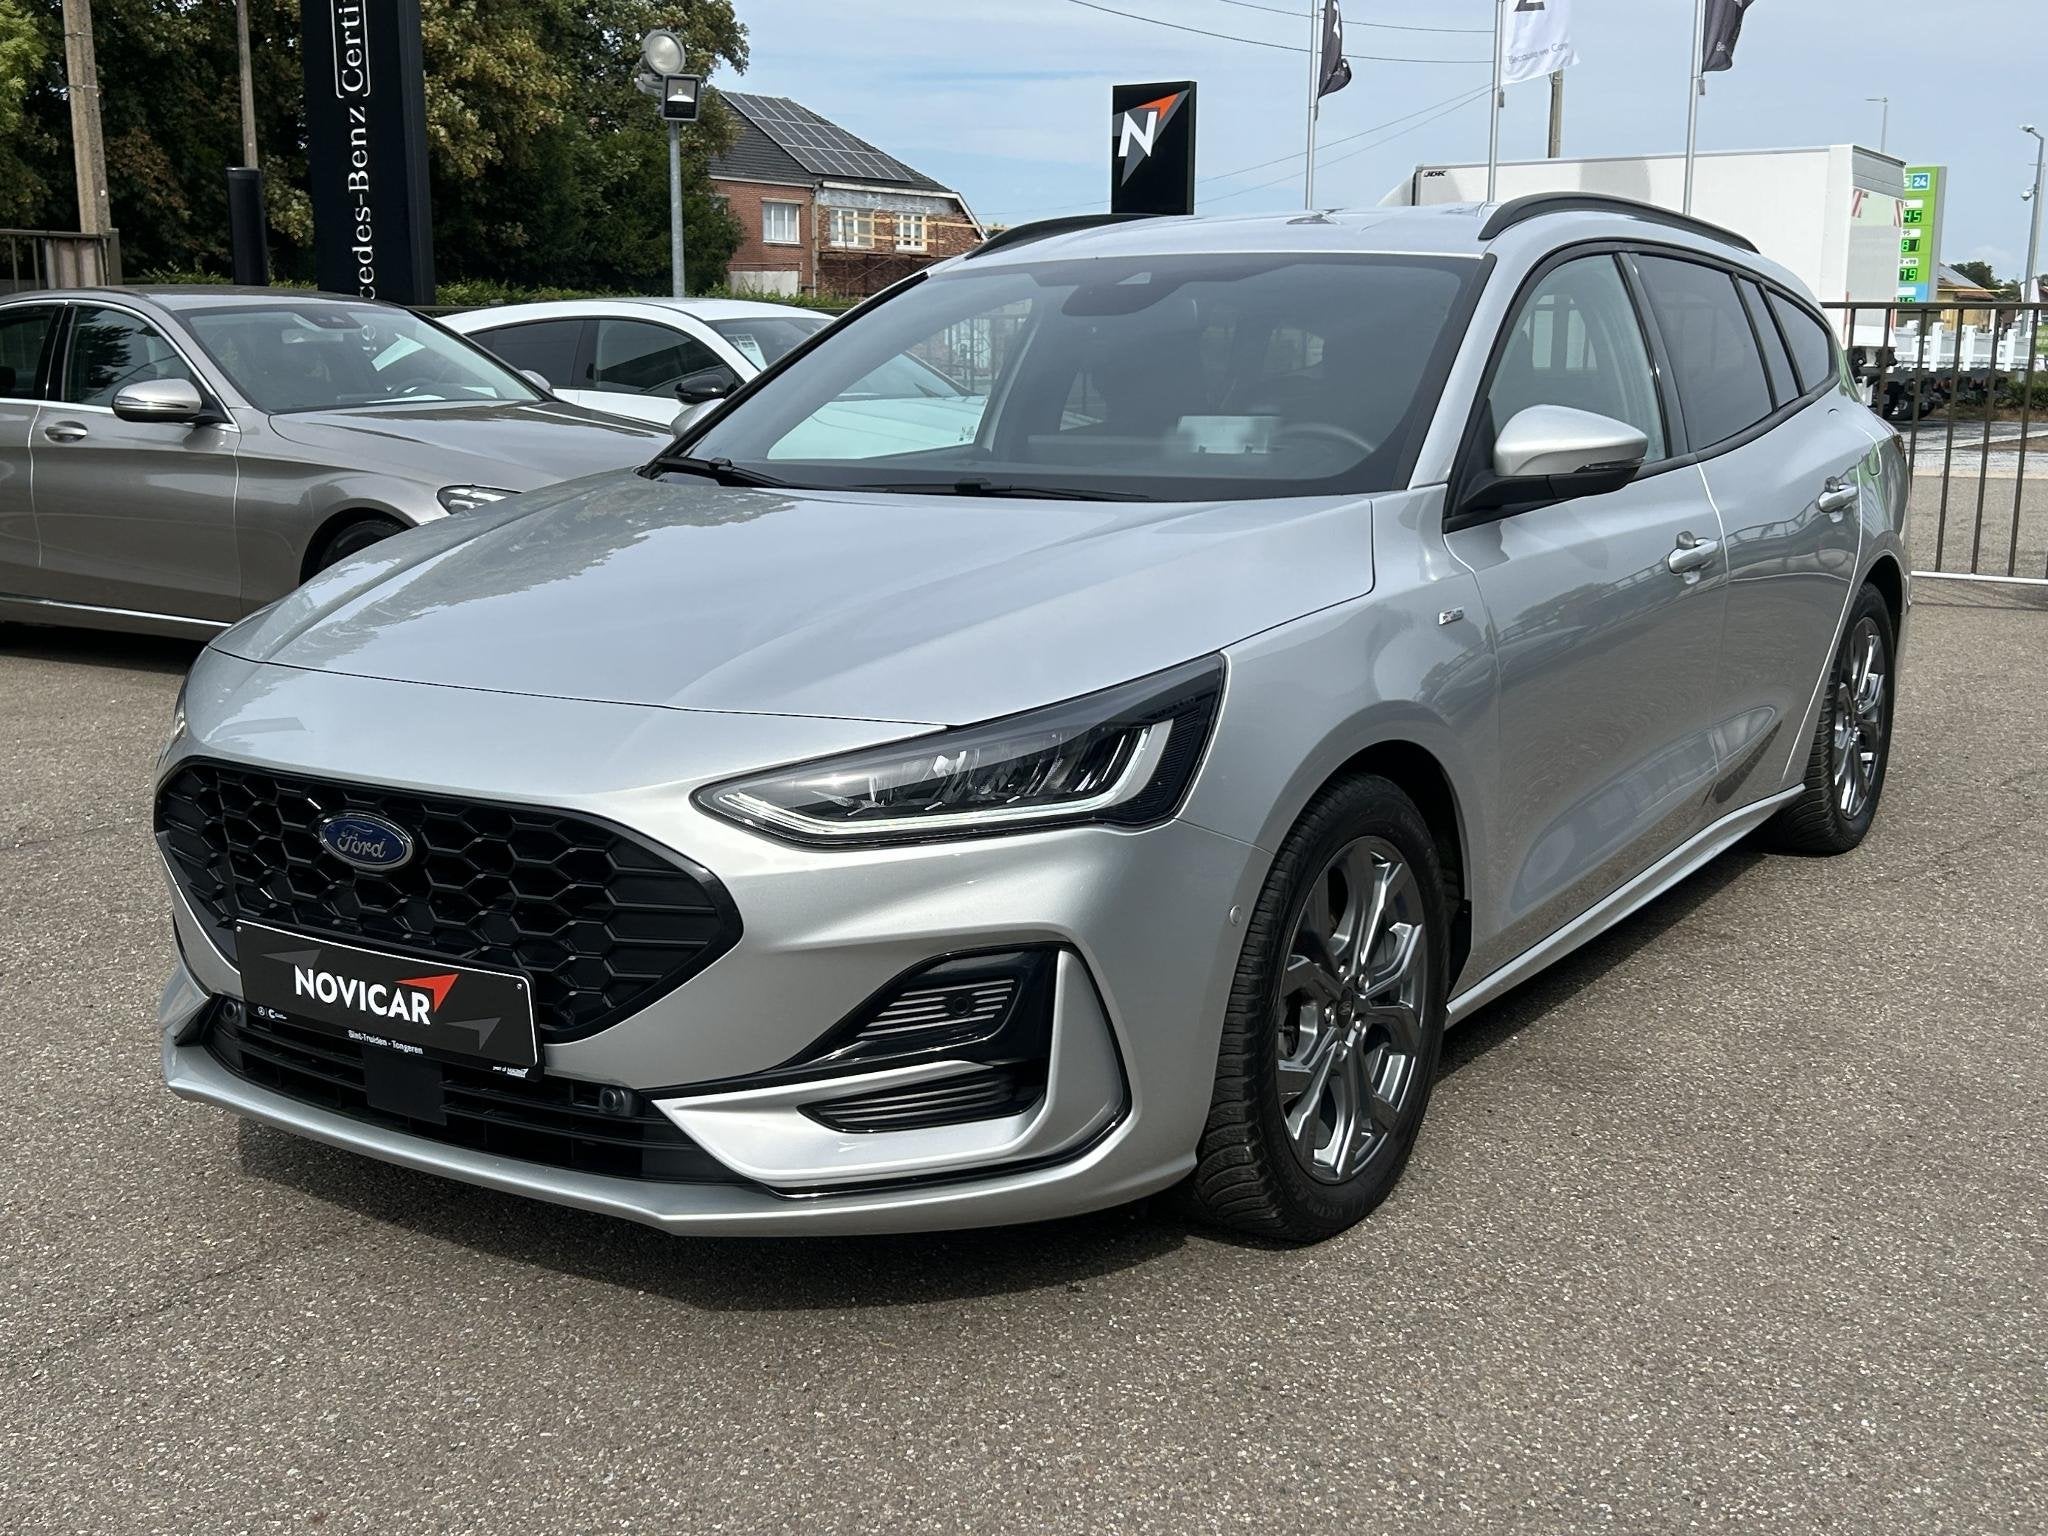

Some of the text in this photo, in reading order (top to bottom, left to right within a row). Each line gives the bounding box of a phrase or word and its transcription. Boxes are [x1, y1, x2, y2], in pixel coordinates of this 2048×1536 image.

[338, 0, 364, 92] Certi
[1118, 111, 1158, 157] N
[1914, 176, 1927, 188] 24
[337, 823, 386, 858] Ford
[294, 965, 431, 1026] NOVICAR
[391, 1040, 424, 1055] Tongeren
